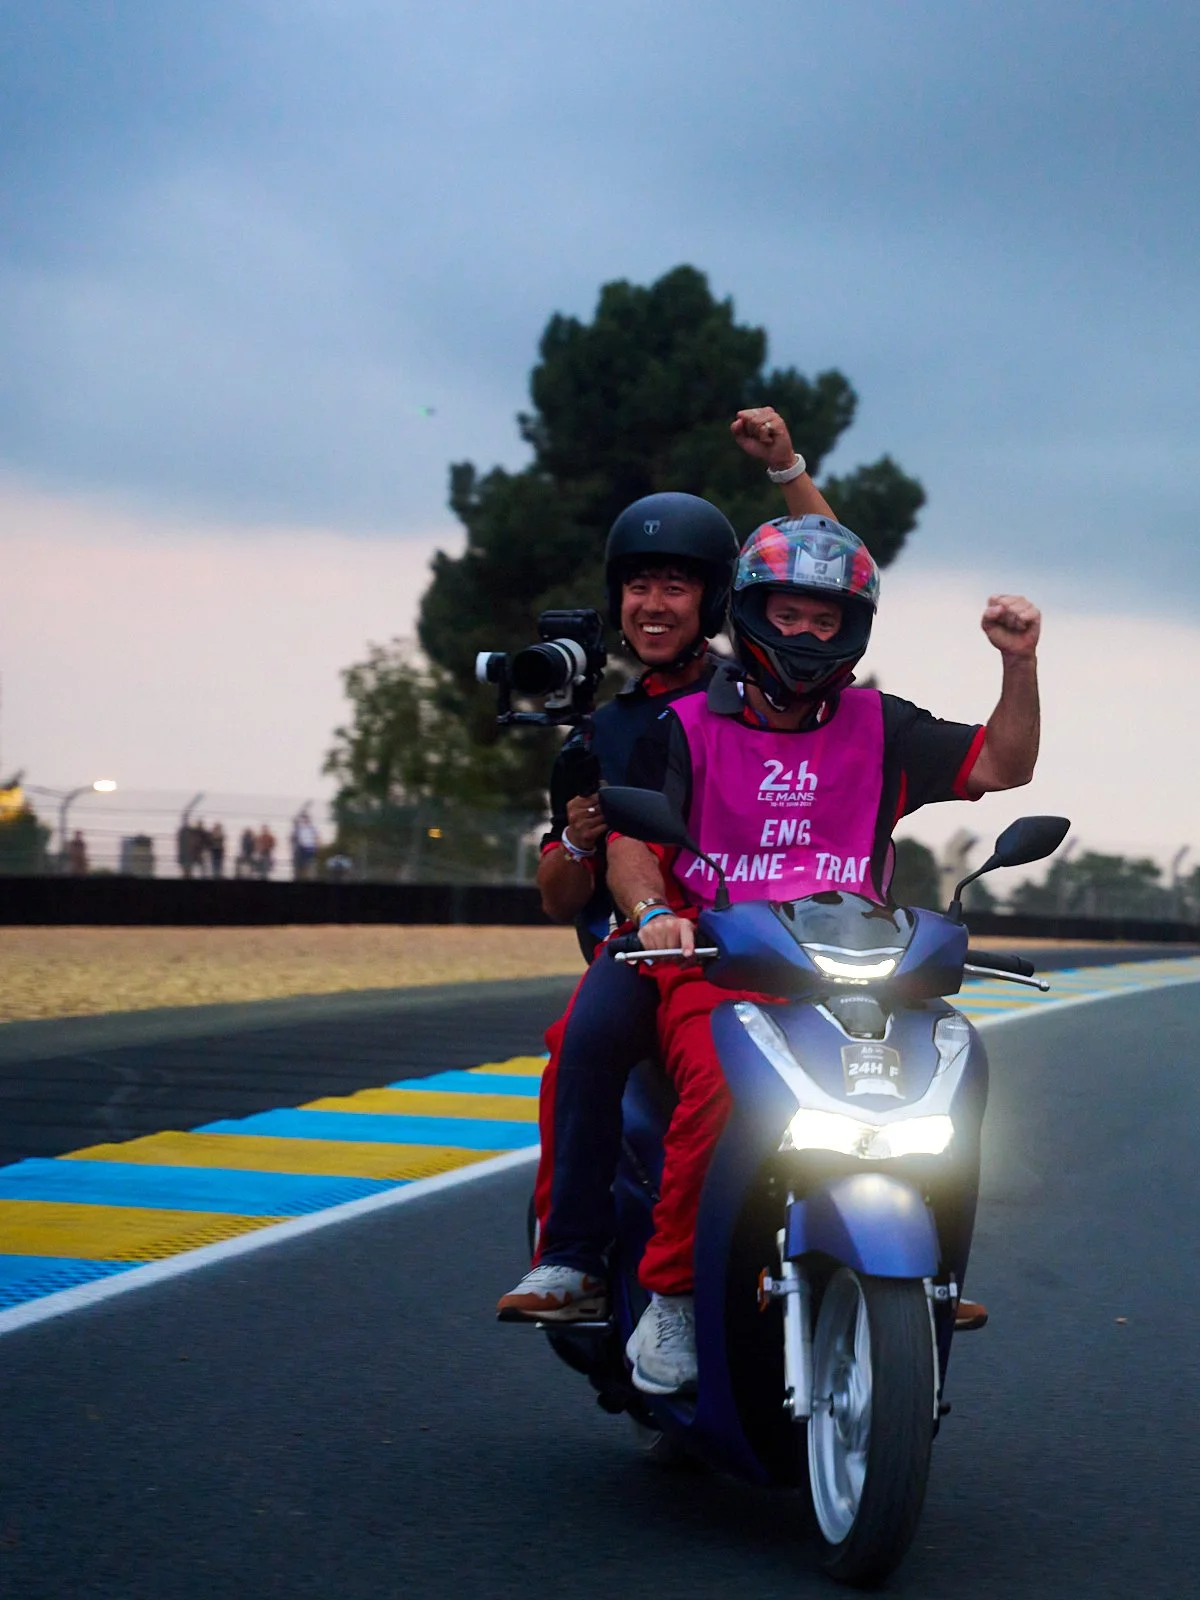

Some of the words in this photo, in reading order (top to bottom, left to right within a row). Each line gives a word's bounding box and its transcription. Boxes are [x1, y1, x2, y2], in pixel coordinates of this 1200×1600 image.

[759, 759, 818, 791] 24h
[757, 792, 774, 801] LE
[775, 792, 815, 802] MANS
[760, 819, 811, 847] ENG
[849, 1062, 883, 1076] 24H
